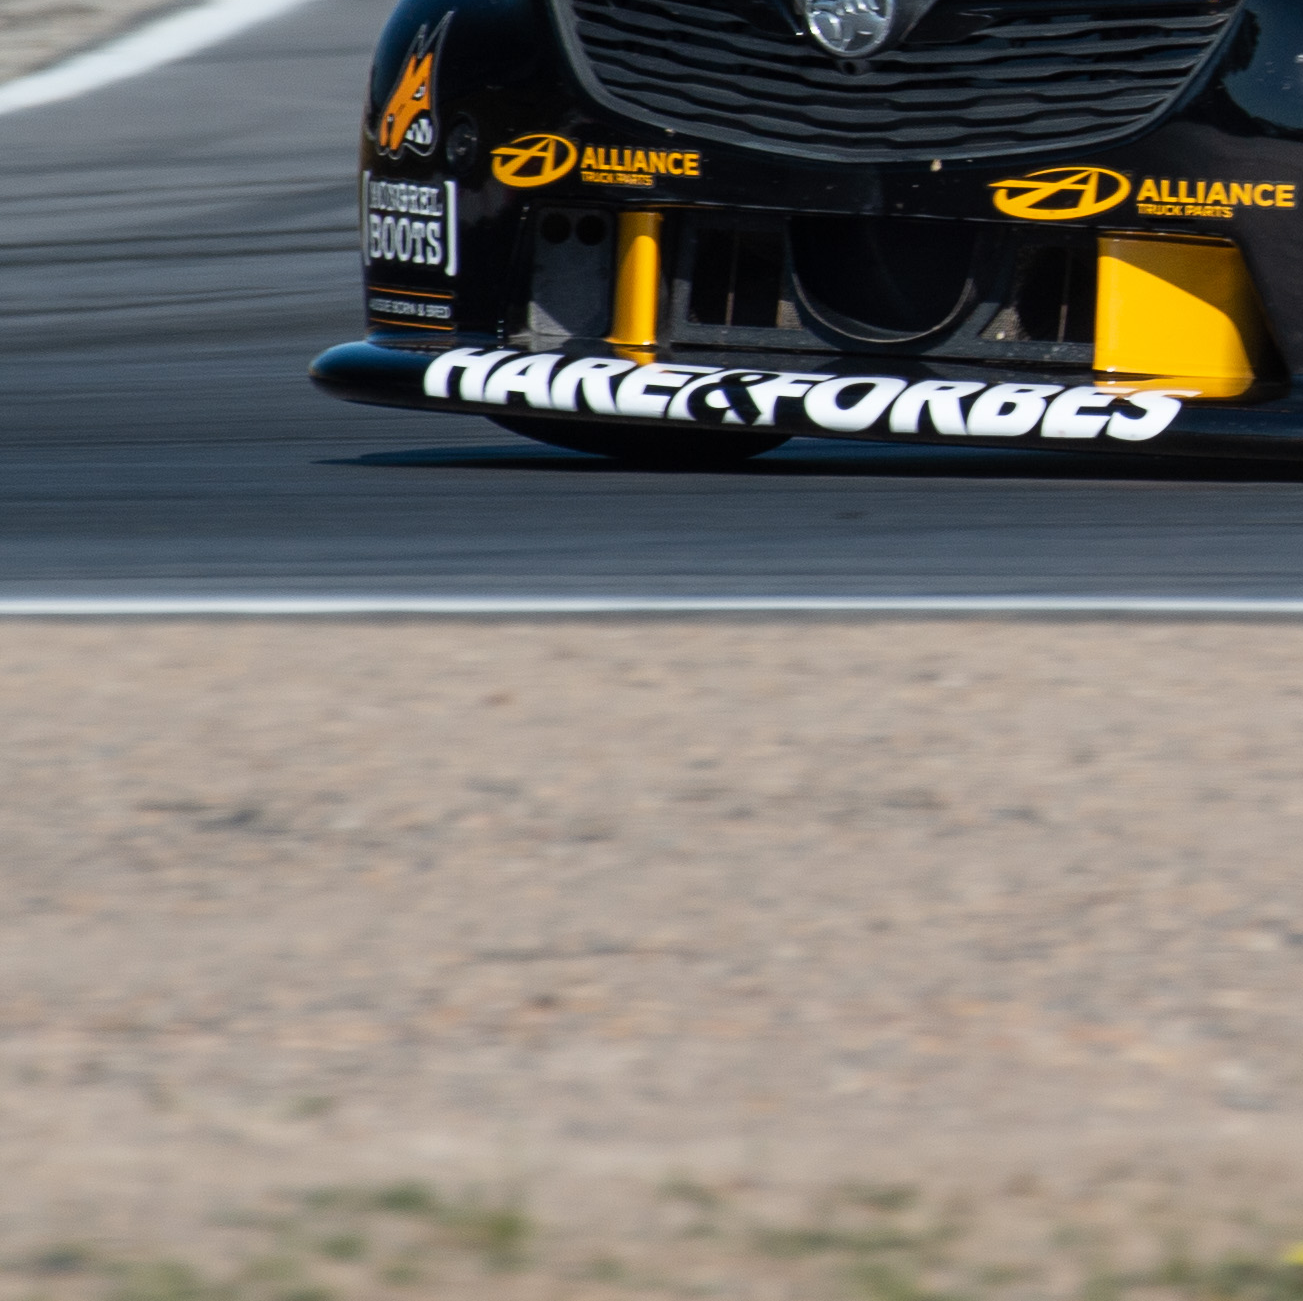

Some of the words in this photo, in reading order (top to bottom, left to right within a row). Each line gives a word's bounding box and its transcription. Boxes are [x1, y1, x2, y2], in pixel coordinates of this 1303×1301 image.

[580, 147, 700, 176] ALLIANCE
[1136, 180, 1296, 207] ALLIANCE
[1137, 203, 1183, 217] TRUCK
[1185, 205, 1234, 218] PARTS
[369, 213, 443, 265] BOOTS
